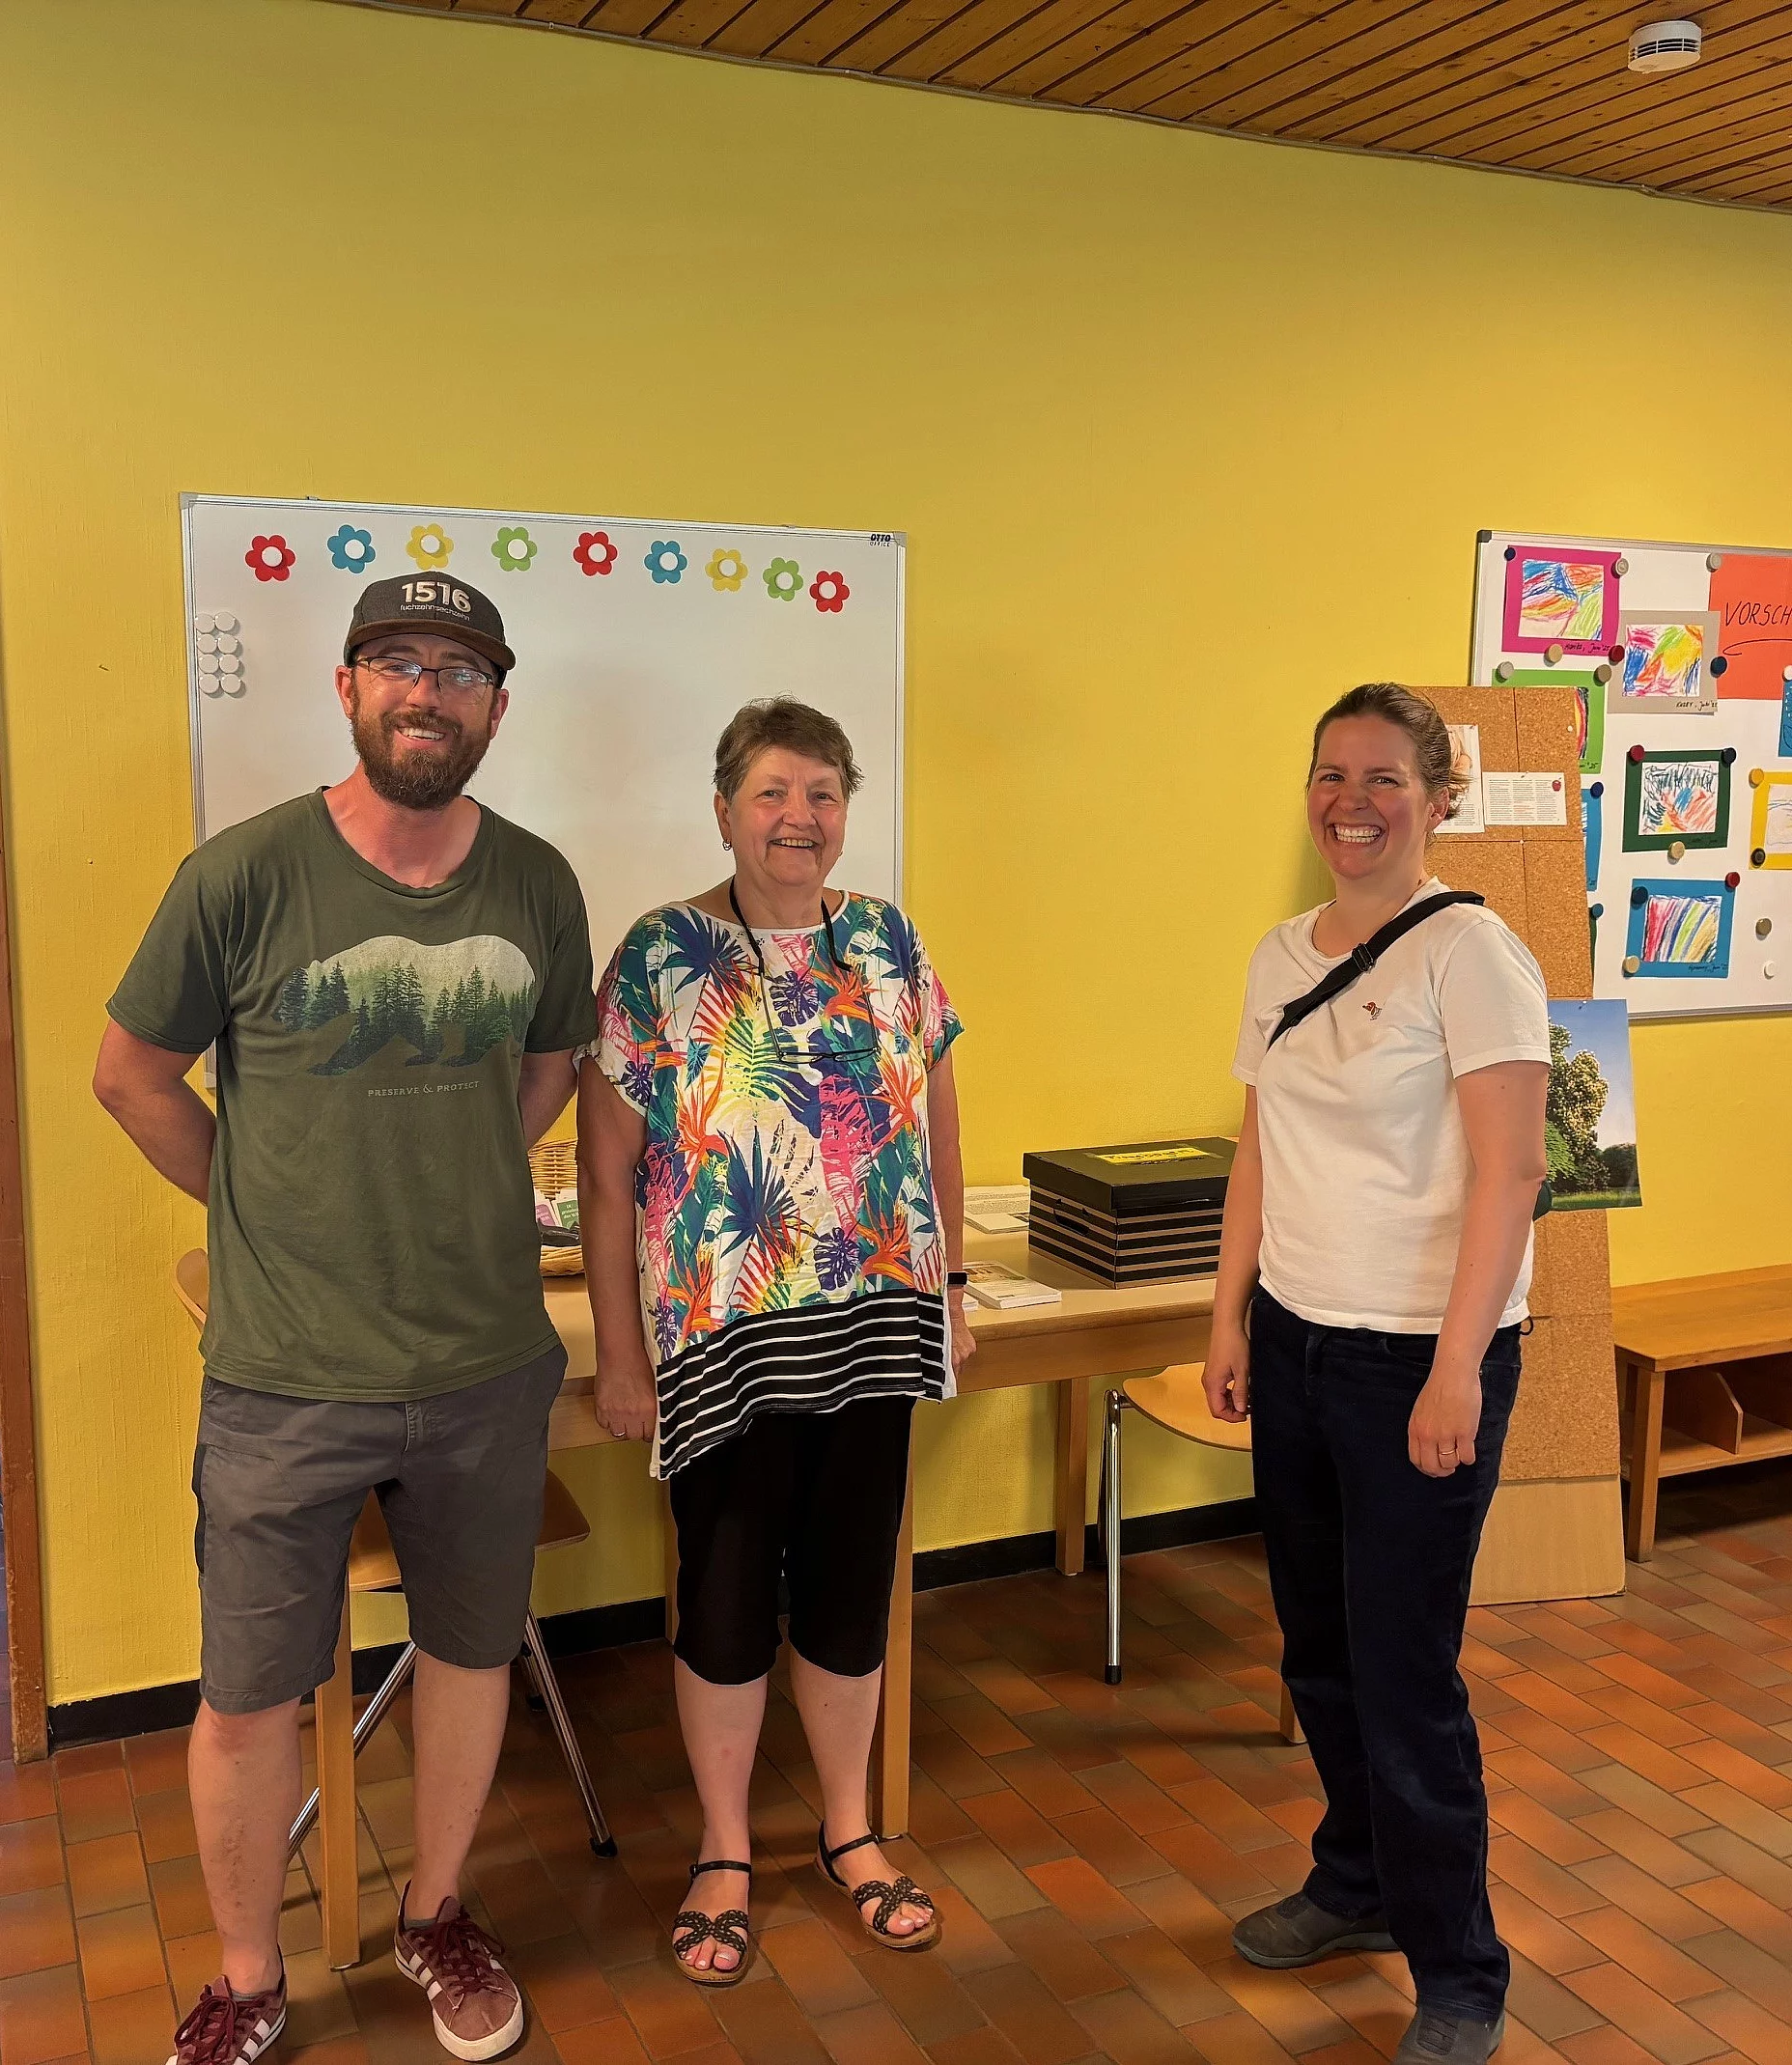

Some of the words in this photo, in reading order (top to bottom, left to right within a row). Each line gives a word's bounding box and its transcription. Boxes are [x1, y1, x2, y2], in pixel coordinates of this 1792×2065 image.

[870, 533, 891, 542] OTTO
[402, 581, 471, 613] 1516
[1725, 600, 1792, 626] VORSCH
[368, 1087, 419, 1097] PRESERVE
[423, 1083, 434, 1093] &
[436, 1080, 480, 1092] PROTECT
